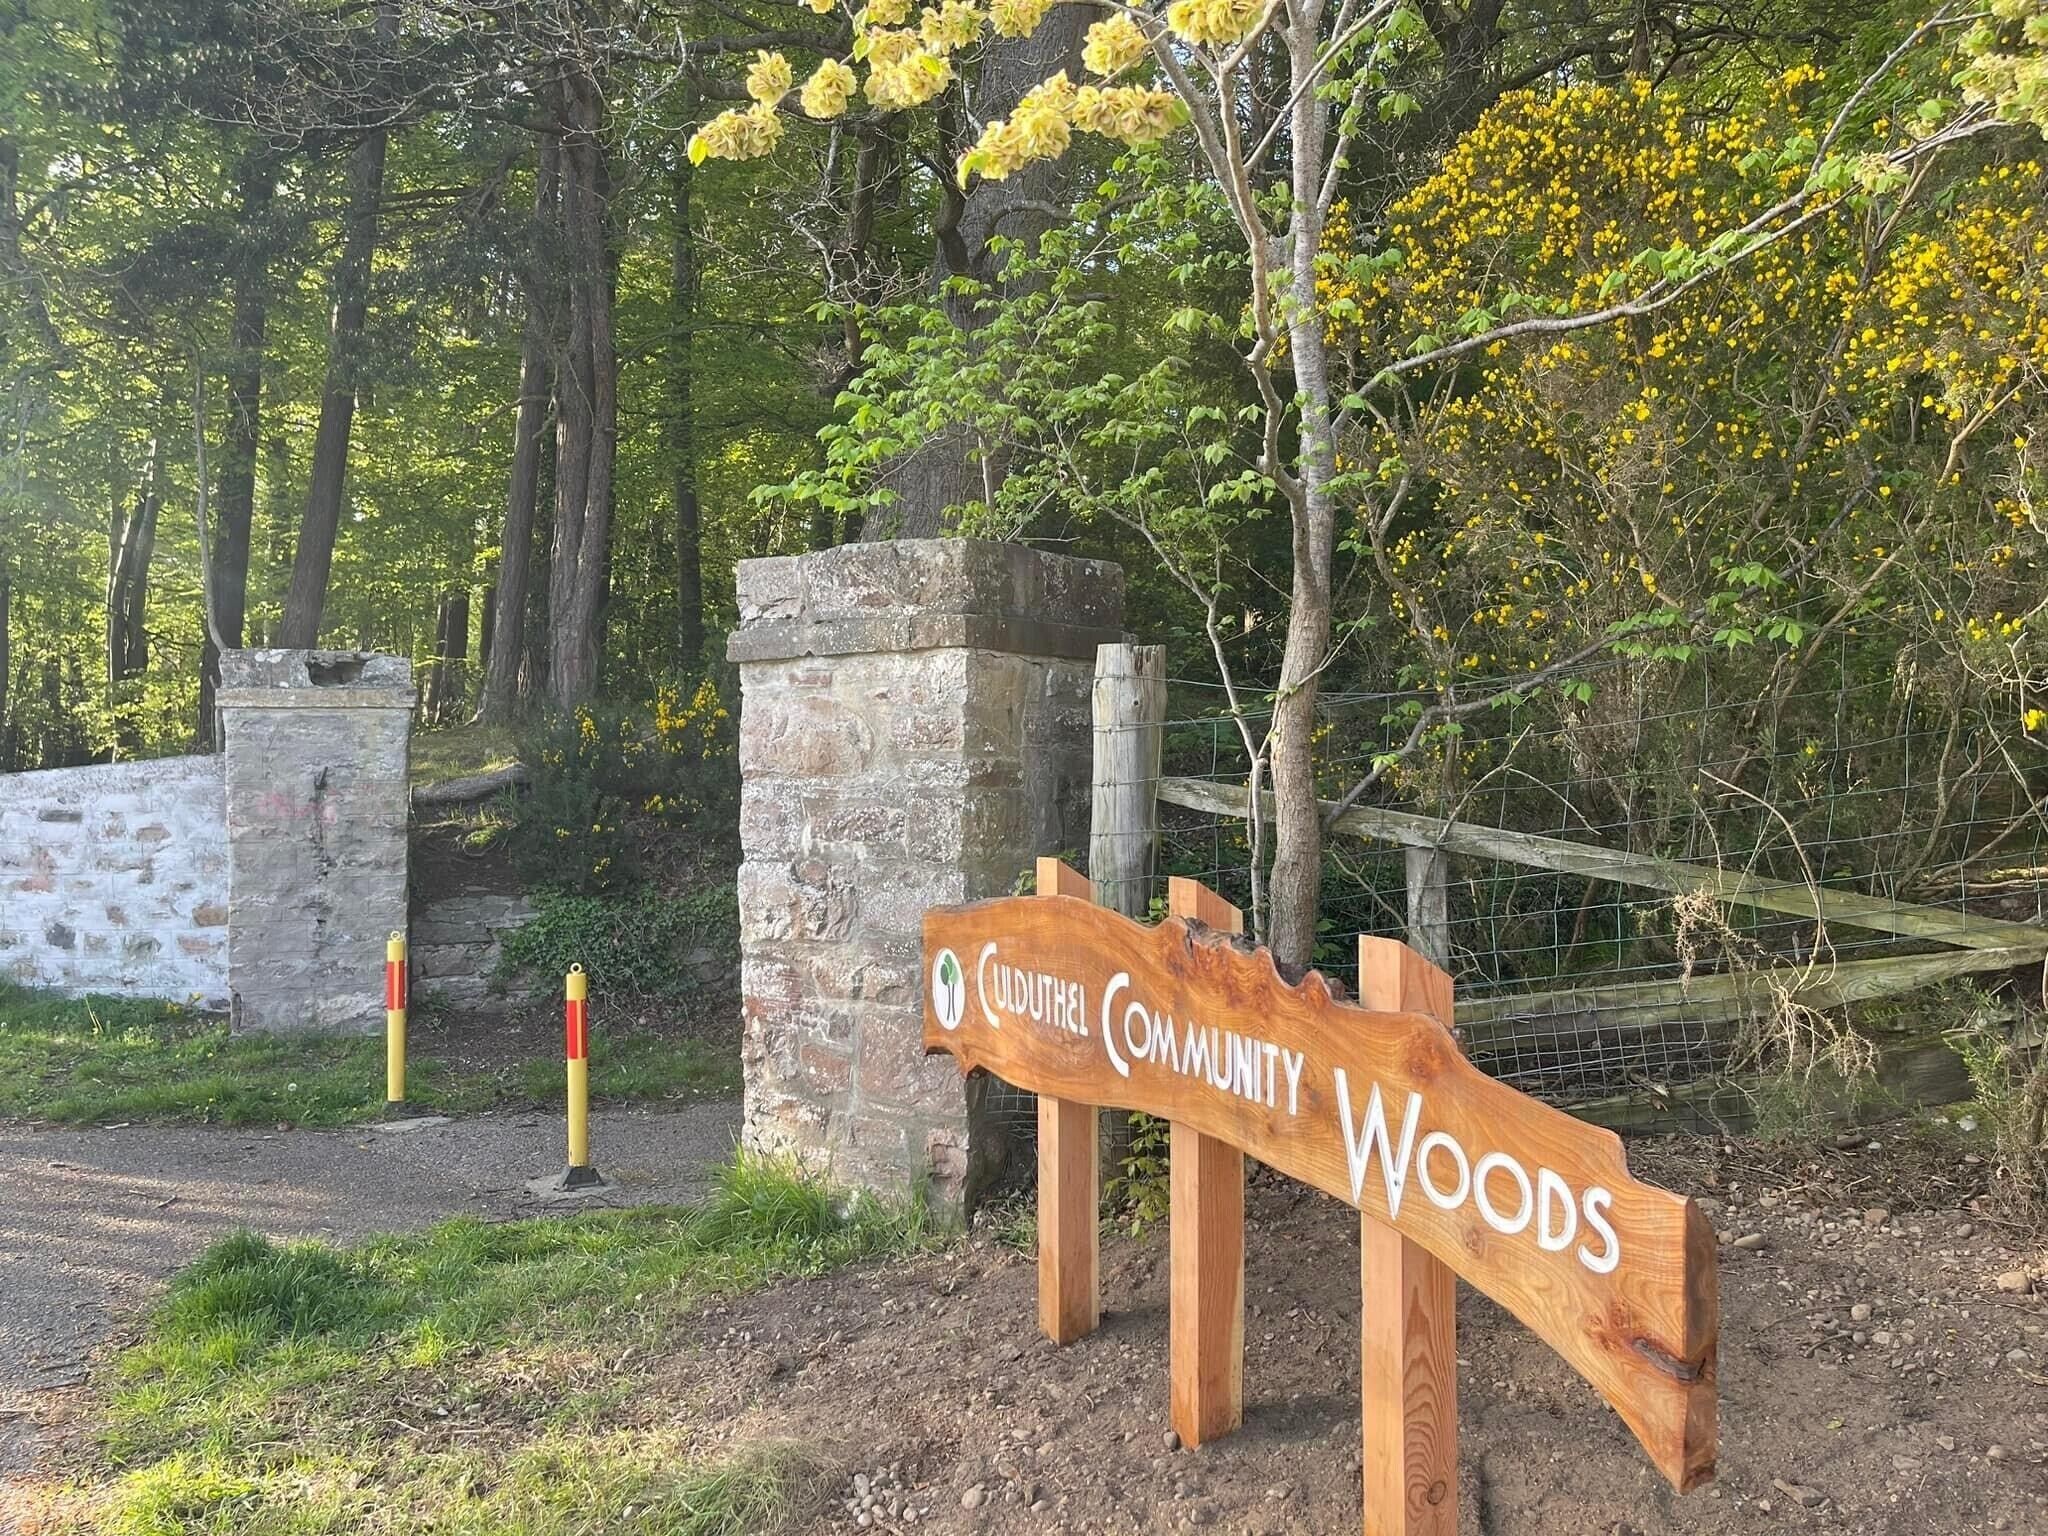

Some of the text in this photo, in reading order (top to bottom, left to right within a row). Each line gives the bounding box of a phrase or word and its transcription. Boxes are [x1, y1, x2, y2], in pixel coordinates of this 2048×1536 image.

[977, 942, 1620, 1274] CULDUTHEL COMMUNITY WOODS
